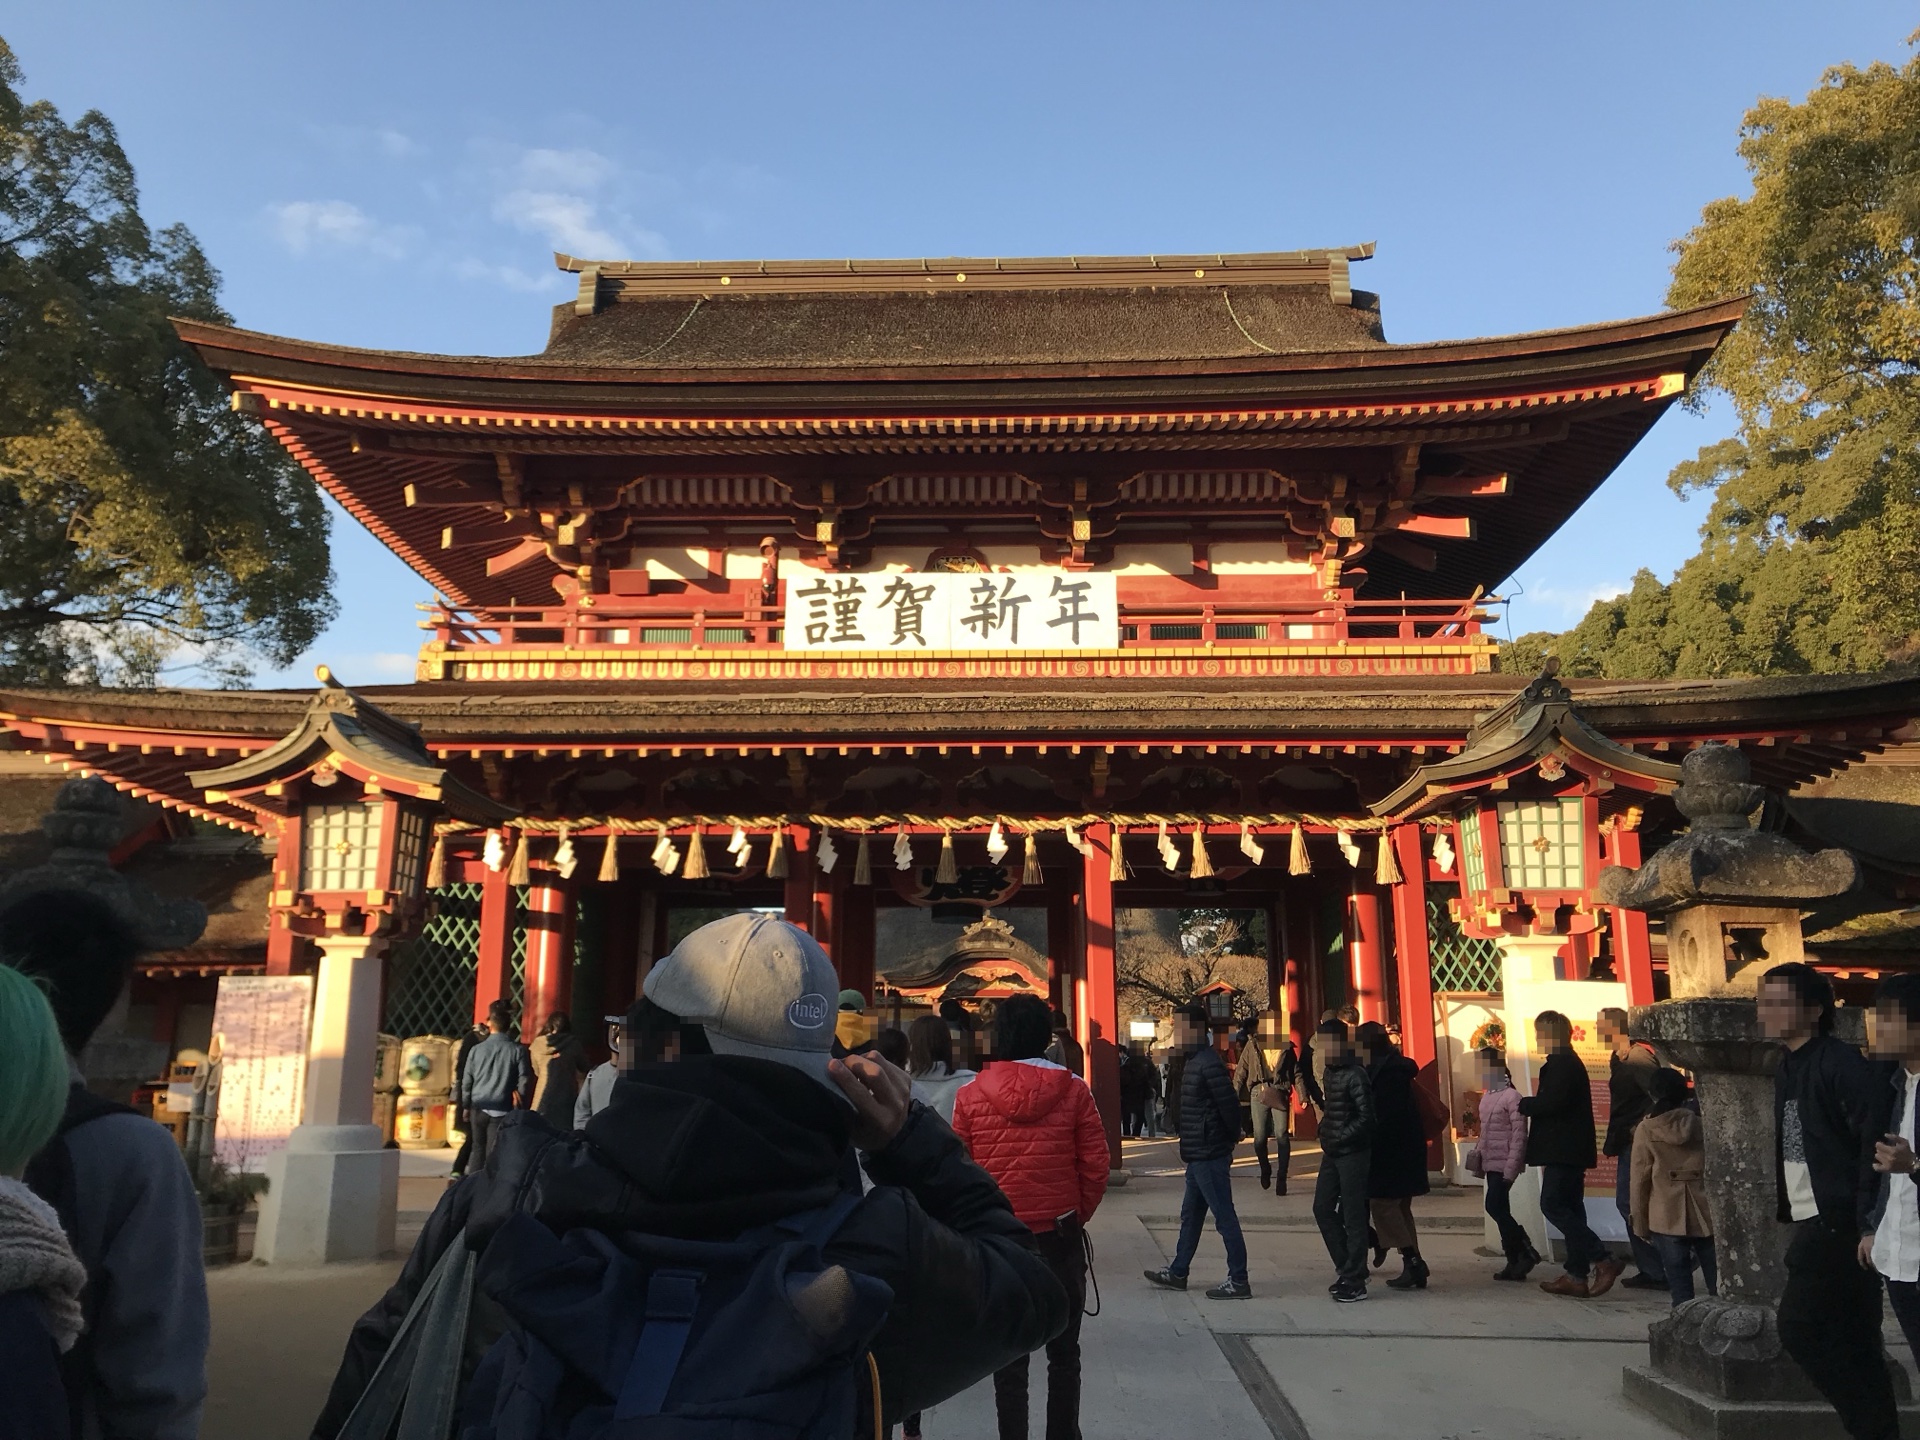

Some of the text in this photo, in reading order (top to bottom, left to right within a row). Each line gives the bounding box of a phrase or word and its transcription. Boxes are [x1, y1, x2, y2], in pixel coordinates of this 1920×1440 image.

[796, 576, 1100, 646] 謹賀新年
[795, 999, 823, 1019] intel
